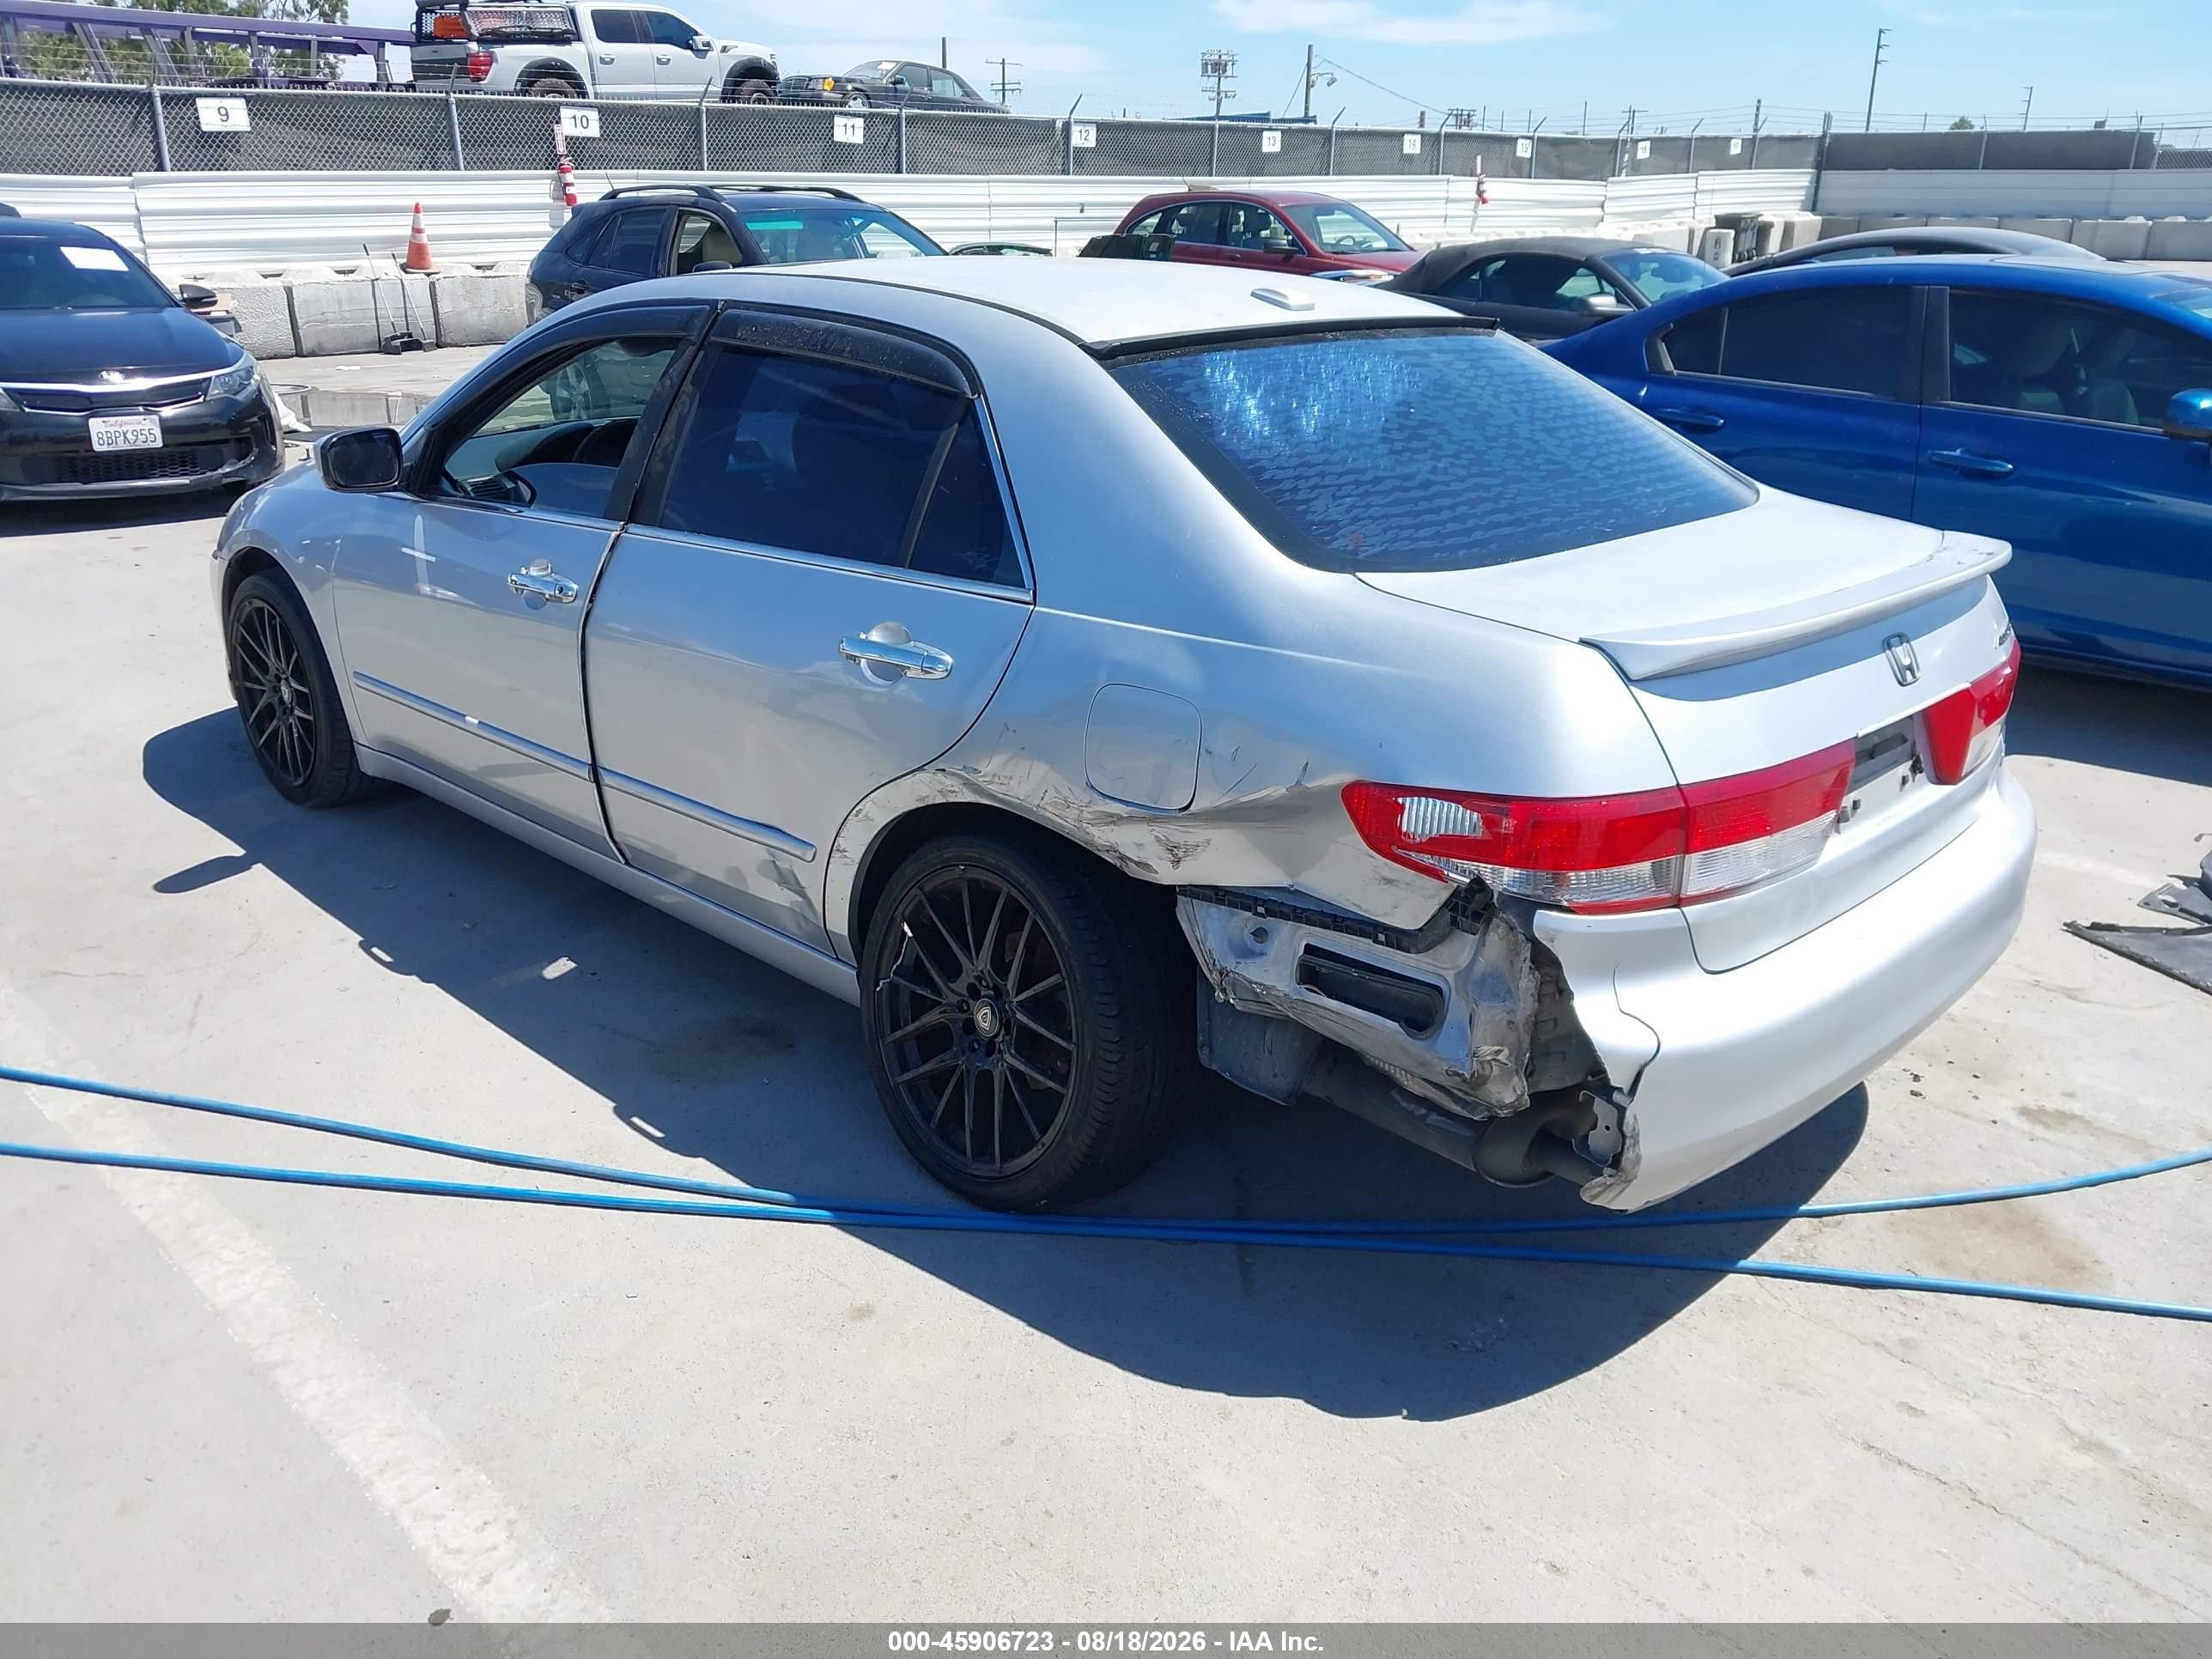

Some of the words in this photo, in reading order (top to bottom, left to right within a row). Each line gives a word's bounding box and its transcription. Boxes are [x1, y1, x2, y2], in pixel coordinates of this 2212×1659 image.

[217, 106, 229, 122] 9
[571, 114, 589, 129] 10
[843, 123, 855, 137] 11
[1079, 130, 1090, 141] 12
[1267, 137, 1277, 147] 13
[96, 428, 157, 447] 8BPK955
